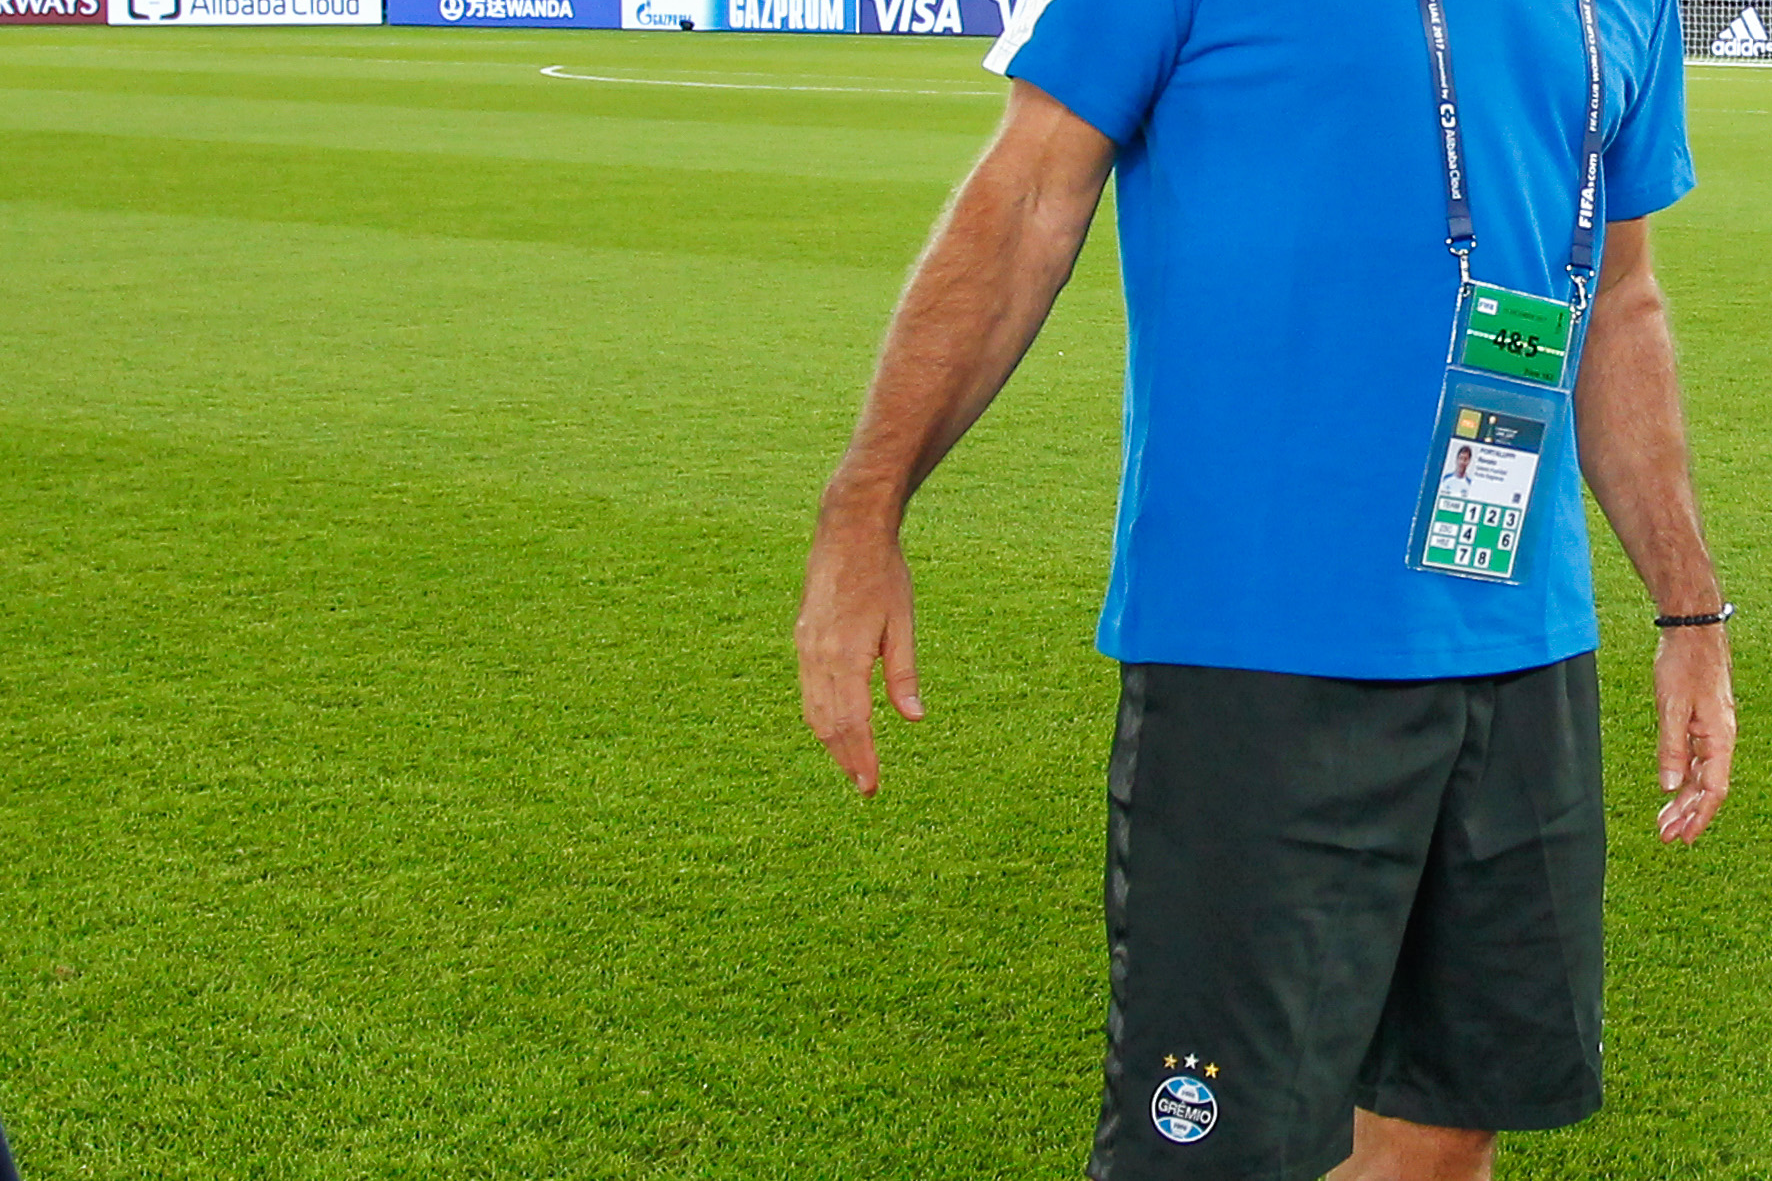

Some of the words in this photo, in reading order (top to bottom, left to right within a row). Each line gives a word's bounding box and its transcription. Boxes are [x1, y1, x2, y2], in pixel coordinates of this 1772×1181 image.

[1428, 3, 1441, 24] UAE
[1432, 25, 1445, 50] 2017
[1591, 83, 1600, 110] CLUB
[1492, 329, 1539, 358] 4&5
[1469, 505, 1477, 521] 1
[1487, 509, 1497, 524] 2
[1506, 512, 1516, 527] 3
[1463, 527, 1473, 541] 4
[1501, 533, 1511, 548] 6
[1459, 548, 1468, 562] 7
[1477, 551, 1487, 566] 8
[1158, 1098, 1211, 1124] GRÊMIO
